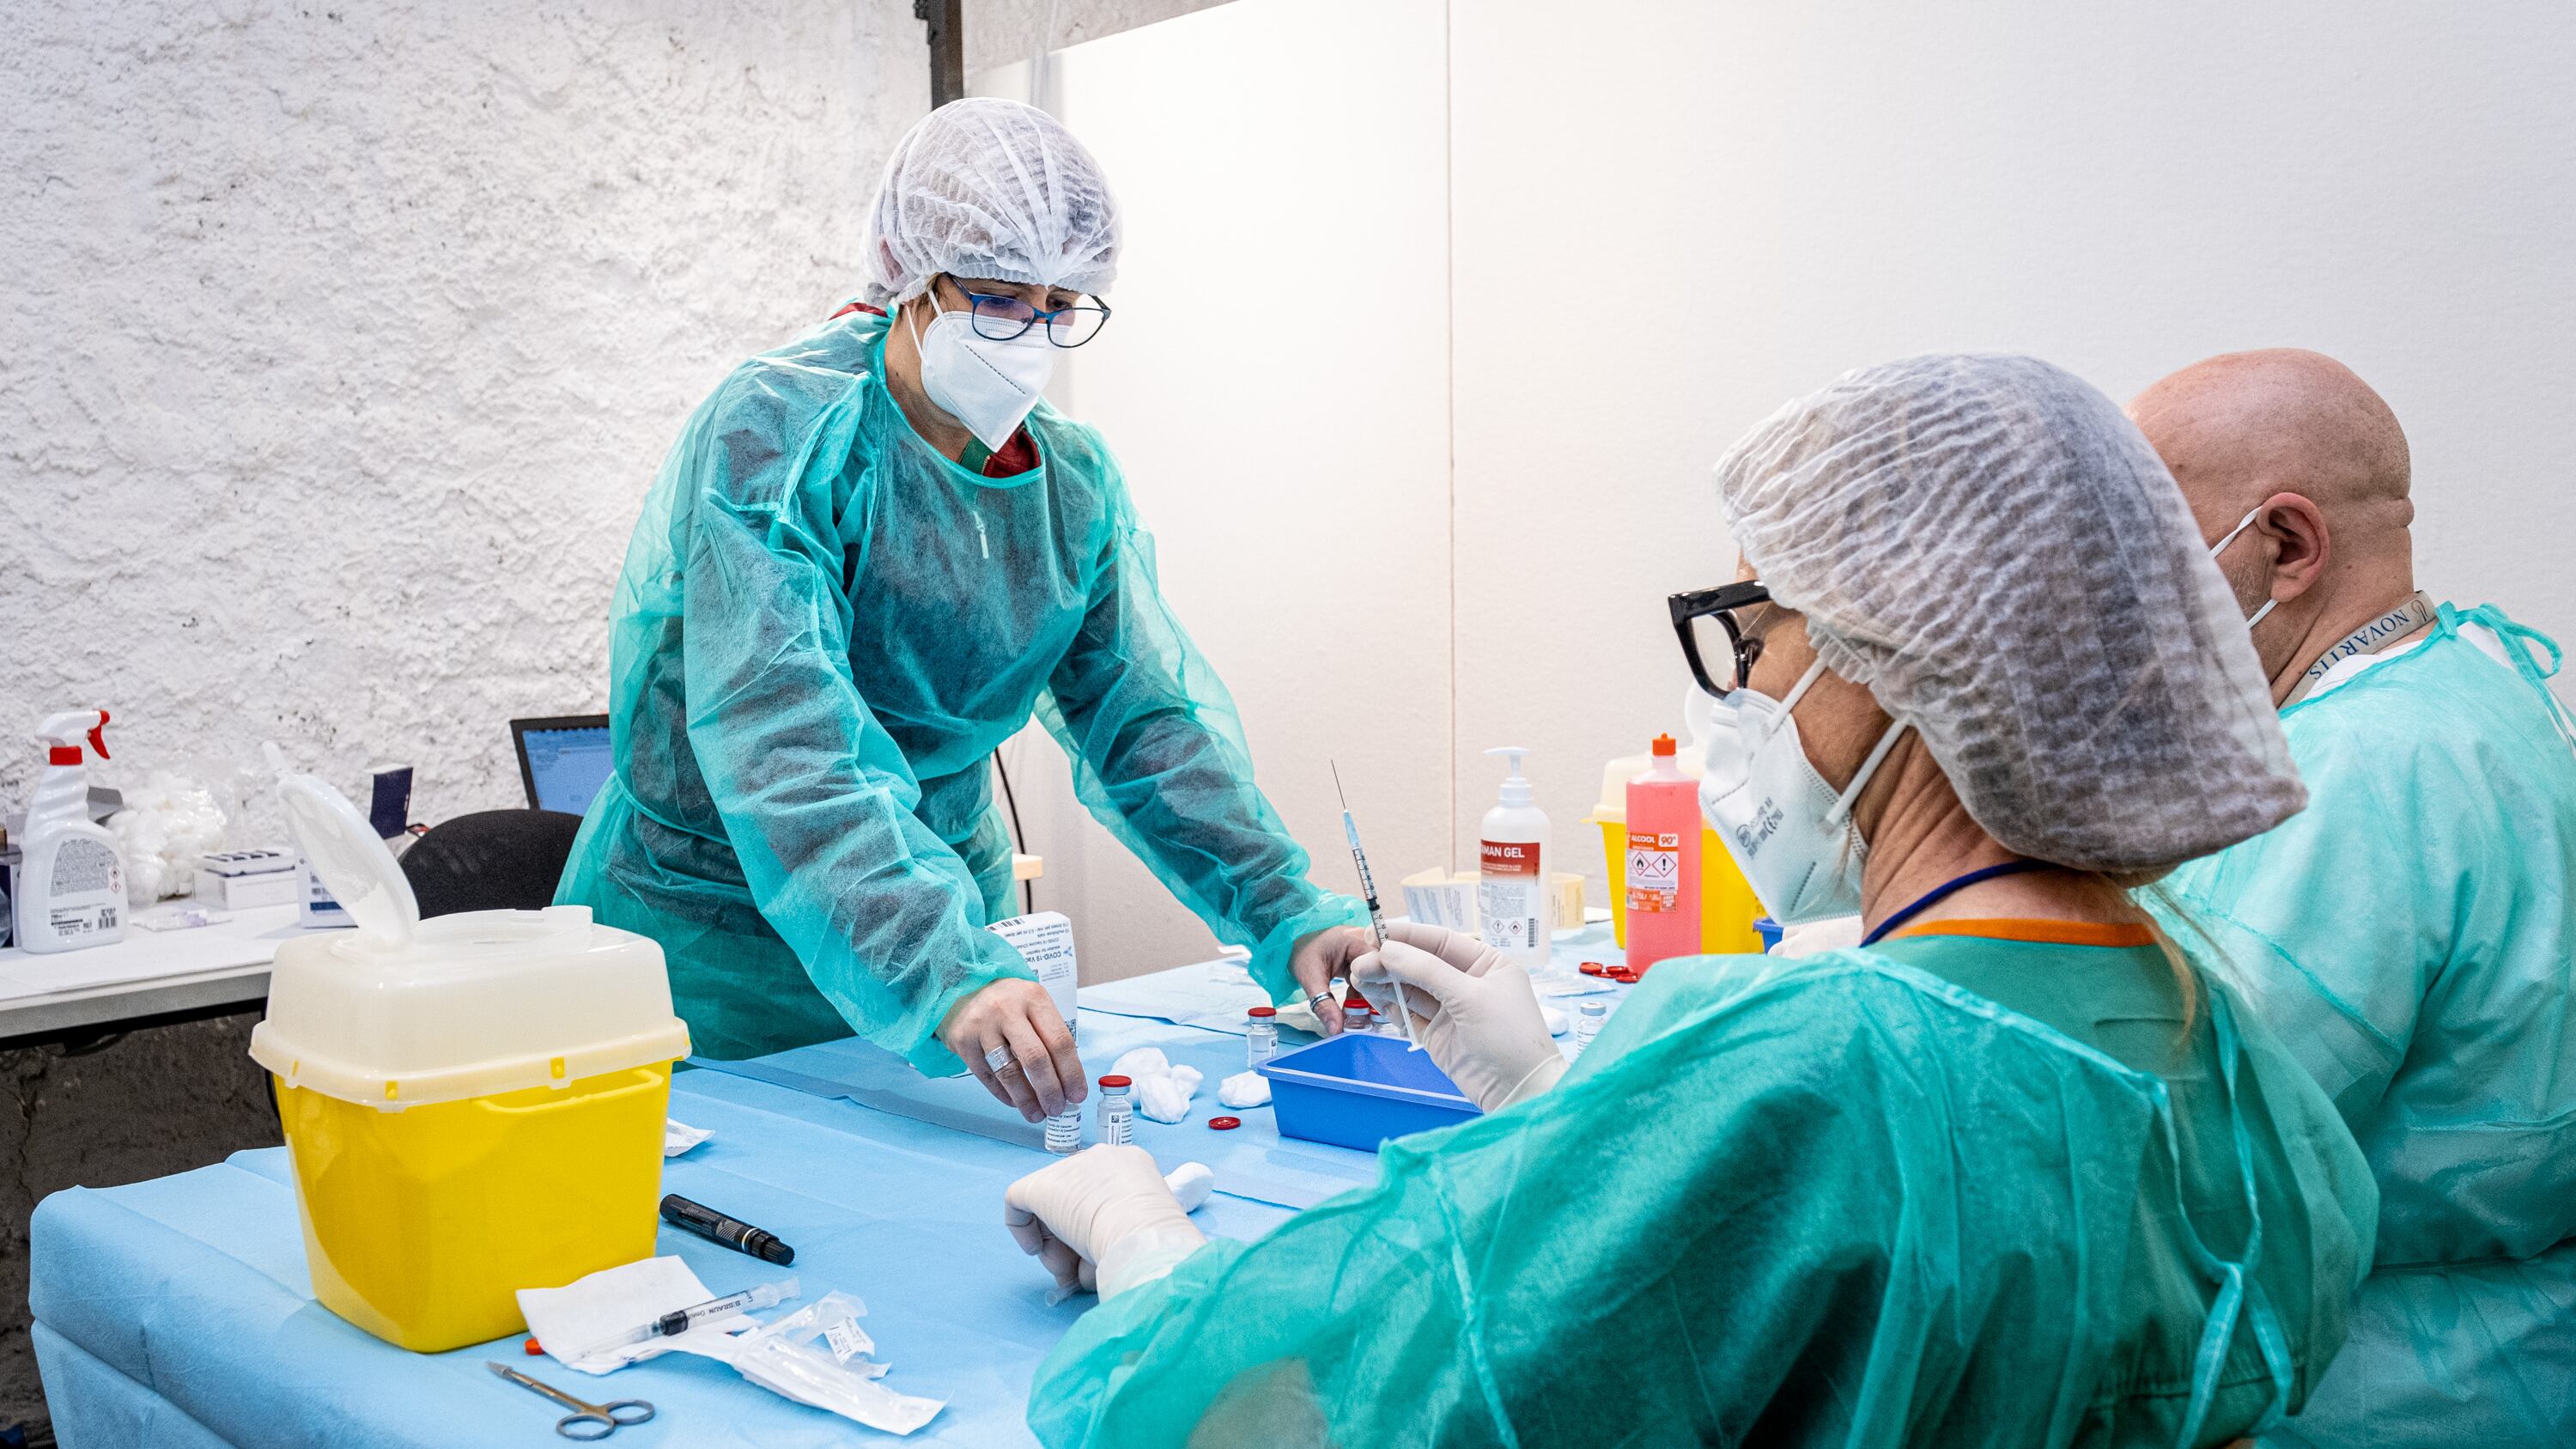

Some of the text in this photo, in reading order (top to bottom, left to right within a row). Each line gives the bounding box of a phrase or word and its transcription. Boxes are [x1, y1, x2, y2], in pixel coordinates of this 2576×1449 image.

[2308, 609, 2410, 680] NOVARTIS
[1631, 834, 1656, 843] ALCOOL
[1504, 846, 1526, 858] GEL
[1036, 951, 1062, 963] COVID-19
[708, 1301, 734, 1314] BRAUN
